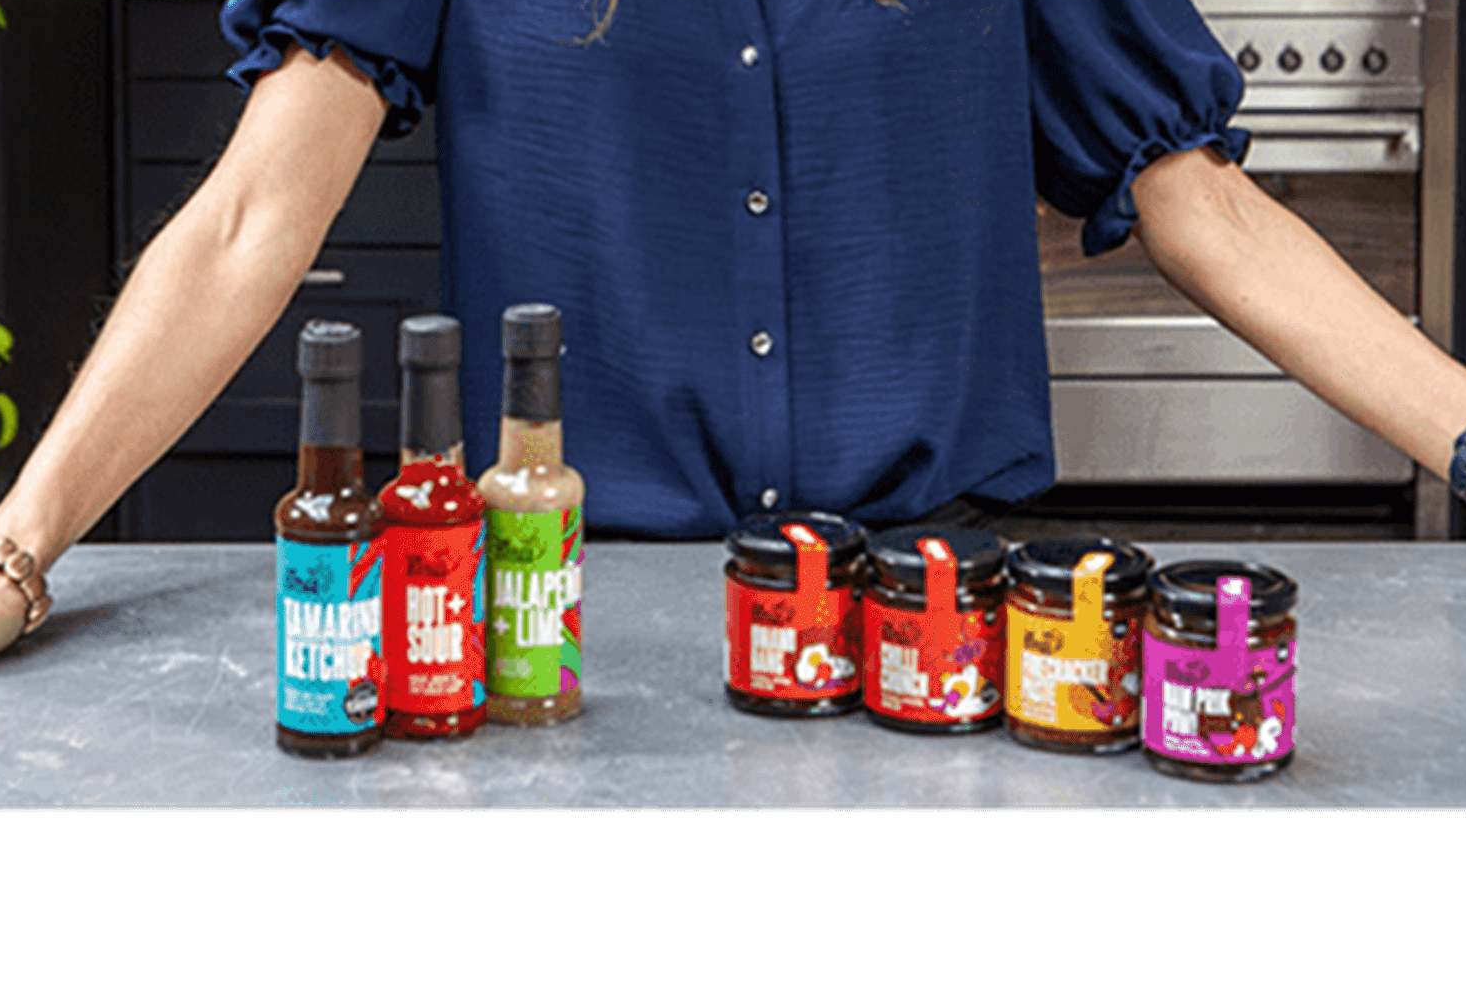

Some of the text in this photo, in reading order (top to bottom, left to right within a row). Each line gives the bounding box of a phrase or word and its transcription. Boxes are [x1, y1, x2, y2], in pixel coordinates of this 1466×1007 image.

[406, 585, 448, 624] HOT
[406, 623, 464, 664] SOUR
[516, 608, 564, 647] LIME
